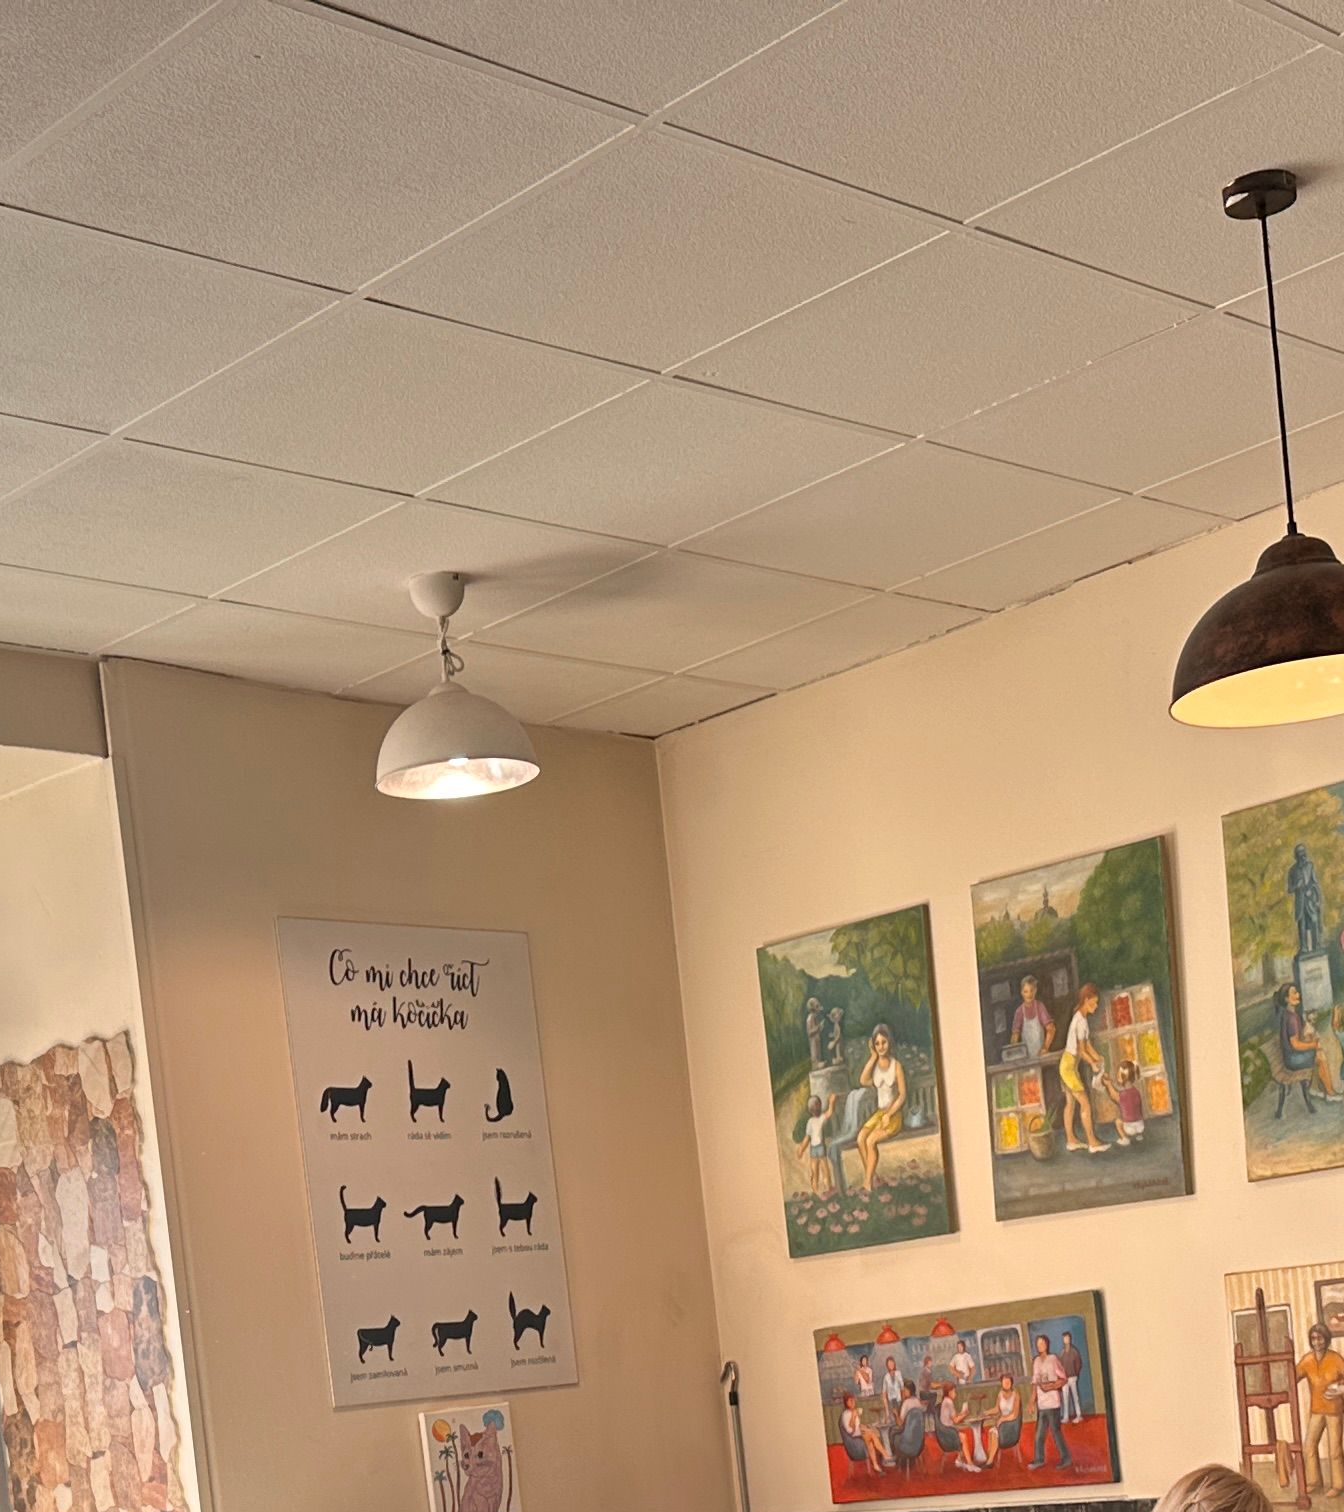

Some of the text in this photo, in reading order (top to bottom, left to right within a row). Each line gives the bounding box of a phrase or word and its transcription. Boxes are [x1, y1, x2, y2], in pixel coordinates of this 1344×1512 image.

[329, 949, 359, 985] Co
[365, 963, 394, 991] mi
[399, 958, 440, 989] chce
[351, 1001, 387, 1031] má
